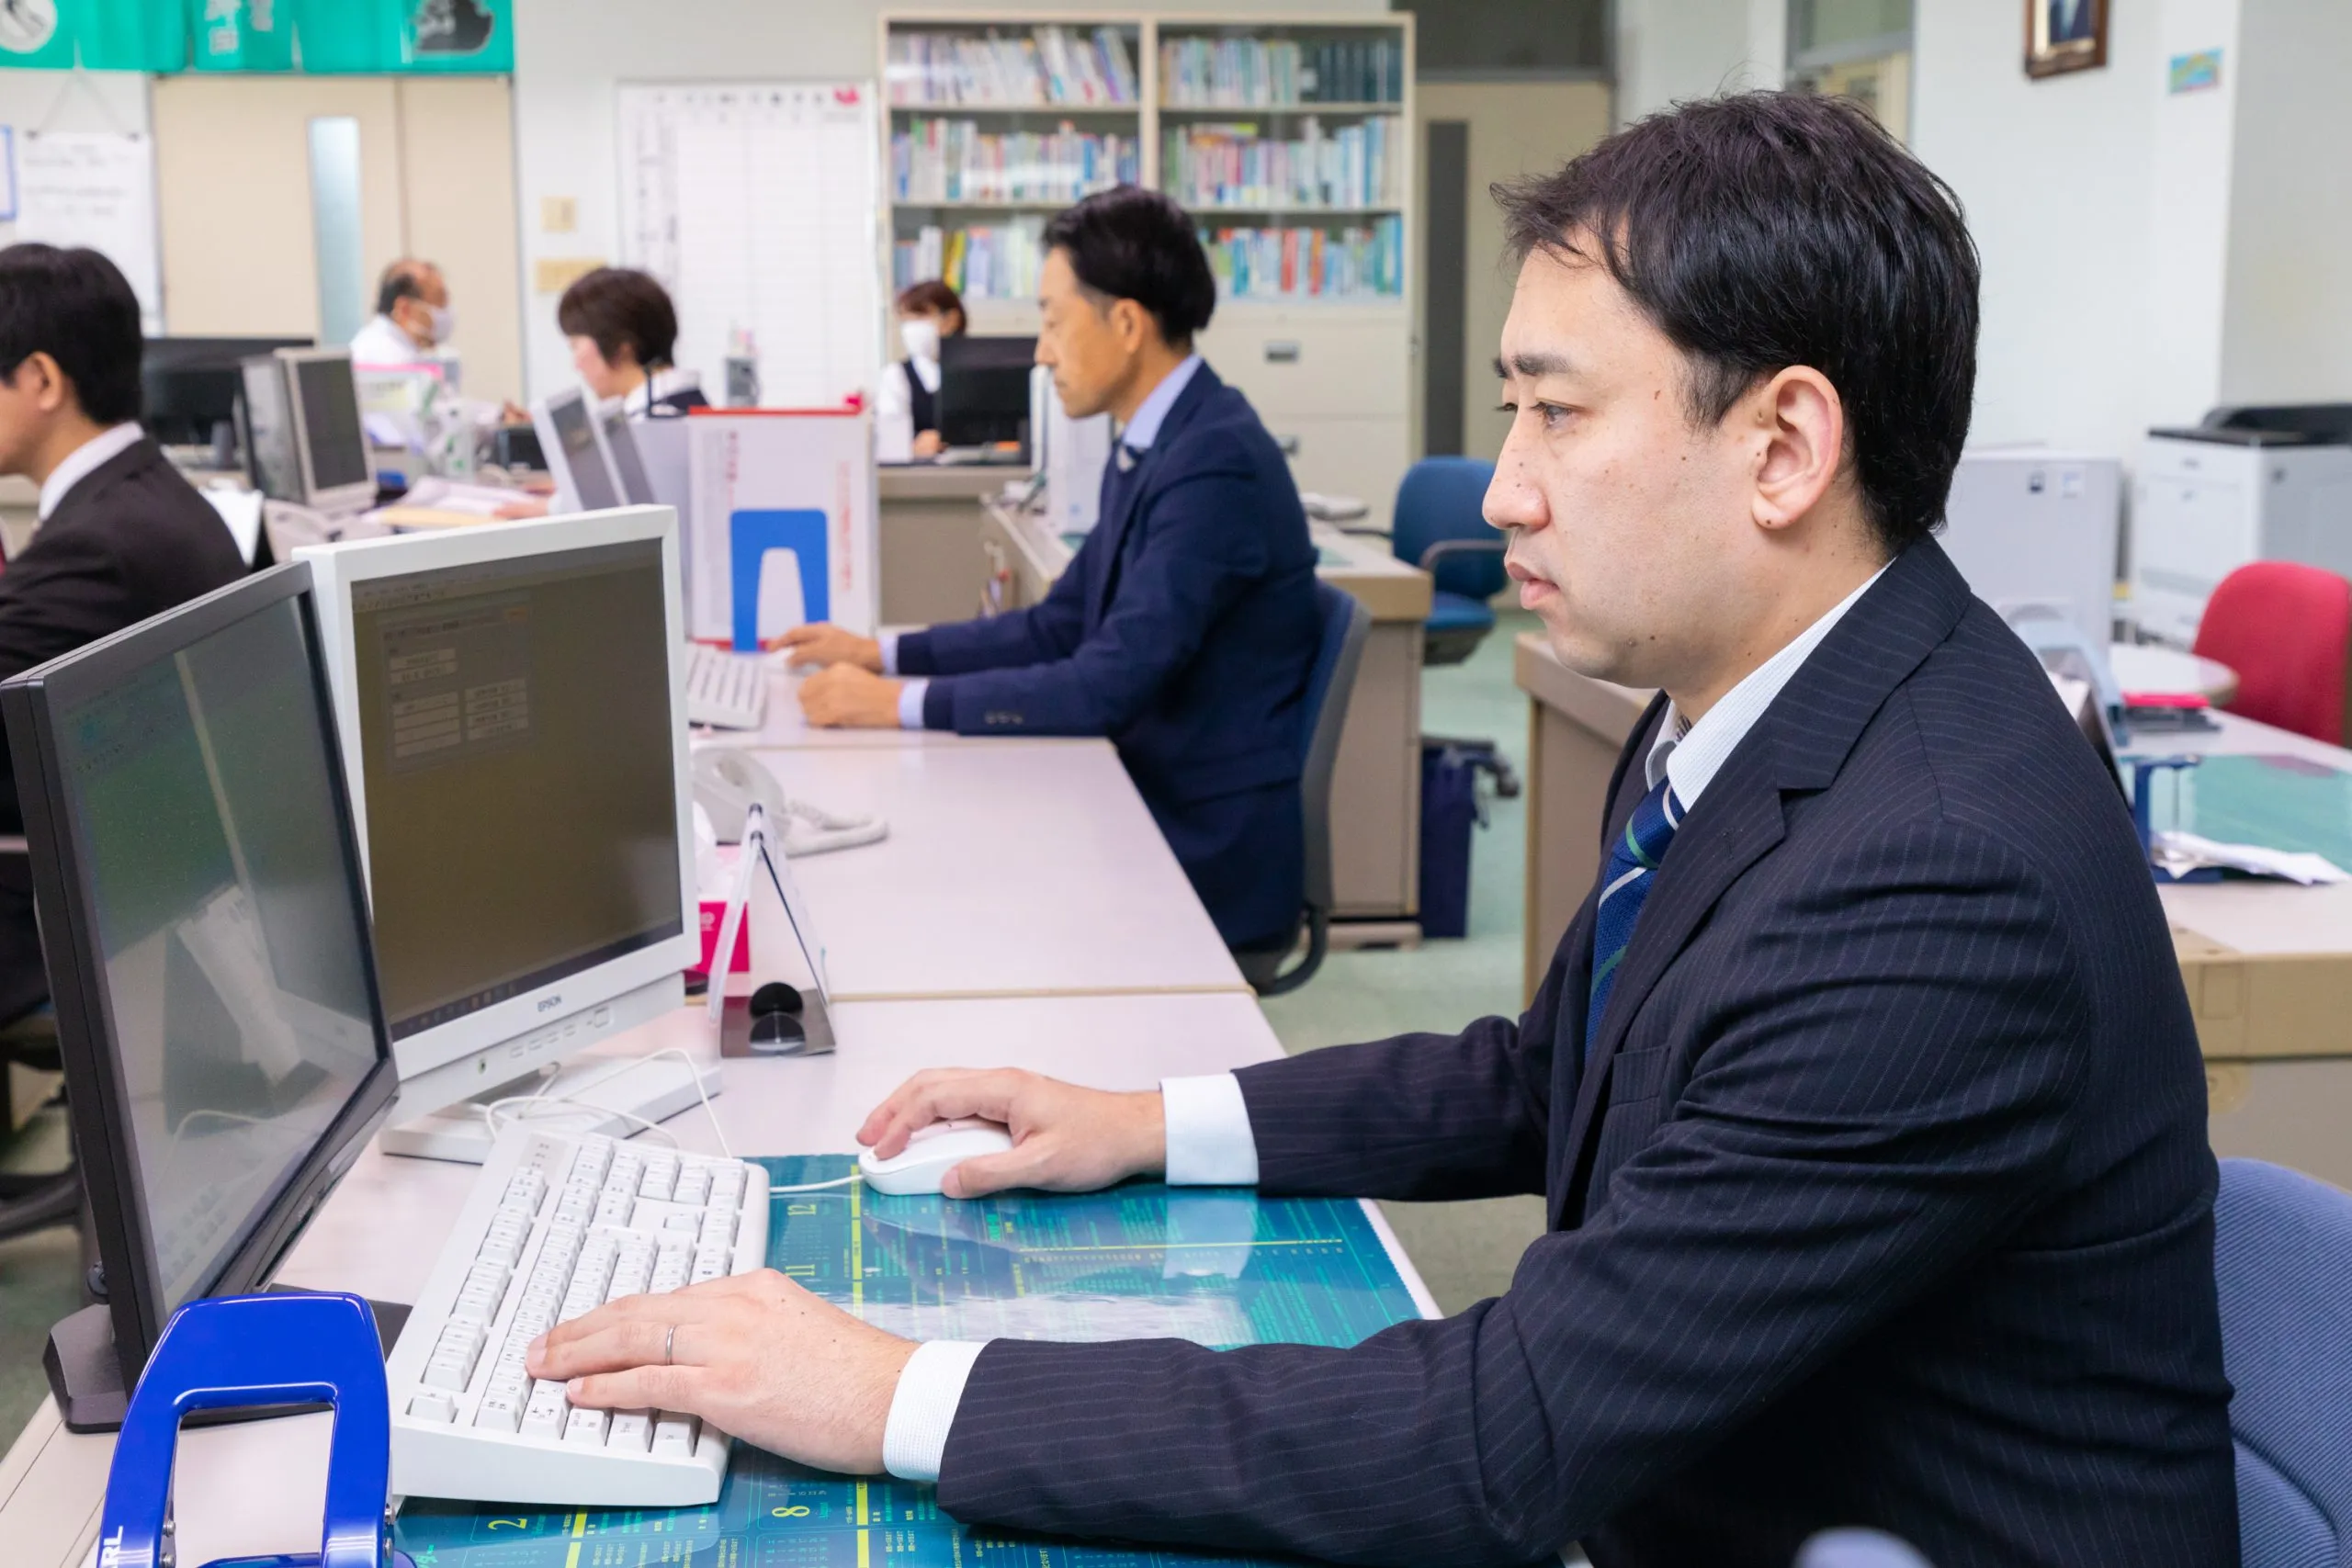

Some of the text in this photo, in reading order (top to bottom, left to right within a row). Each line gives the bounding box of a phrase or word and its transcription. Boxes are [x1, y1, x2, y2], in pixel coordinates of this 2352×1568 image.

[537, 995, 561, 1012] EPSON
[786, 1203, 817, 1216] 12
[785, 1264, 816, 1277] 11
[771, 1506, 810, 1517] 8
[487, 1517, 527, 1530] 2
[100, 1525, 124, 1568] RL
